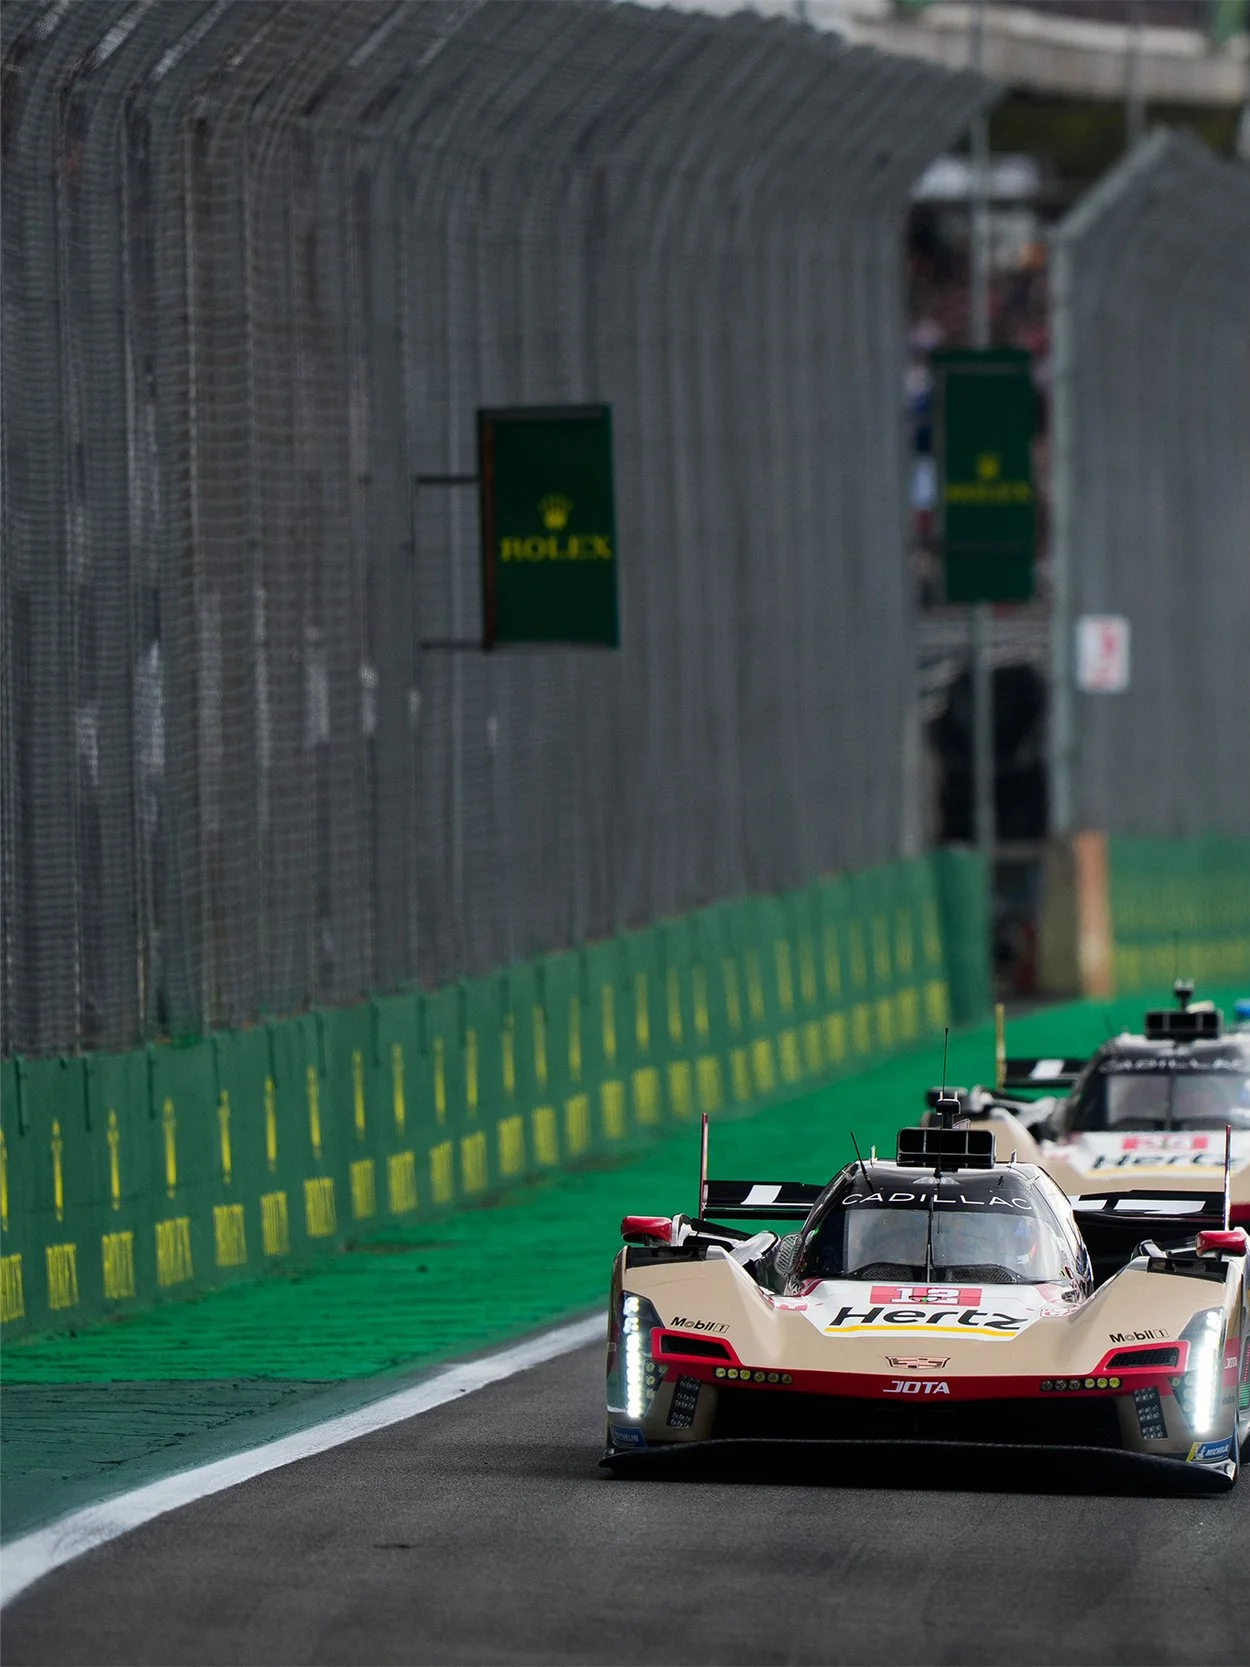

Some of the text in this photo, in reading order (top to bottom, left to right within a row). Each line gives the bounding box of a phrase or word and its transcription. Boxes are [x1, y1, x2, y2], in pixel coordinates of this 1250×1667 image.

[500, 535, 612, 561] ROLEX
[842, 1192, 1033, 1210] CADILLAC
[889, 1287, 960, 1304] 12
[670, 1316, 715, 1332] Mobil
[829, 1306, 1029, 1330] Hertz
[1109, 1330, 1154, 1343] Mobil
[883, 1380, 950, 1394] JOTA
